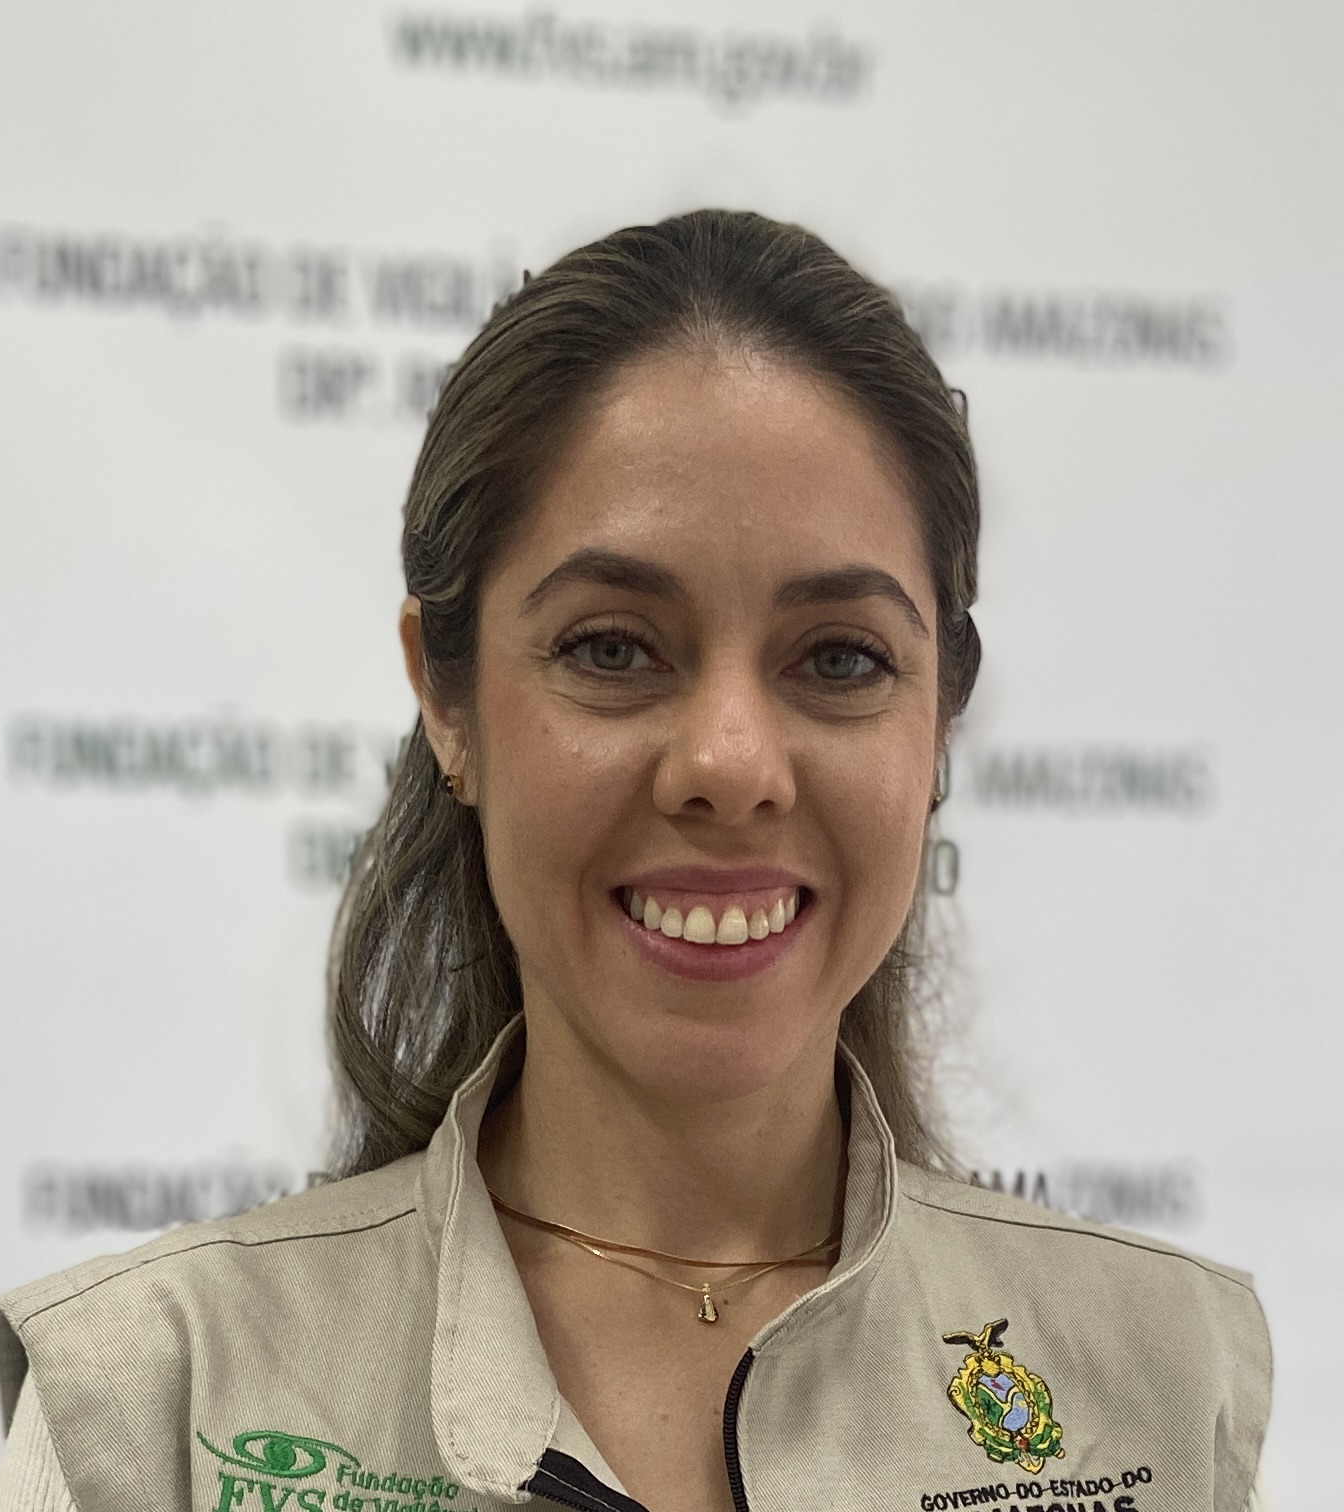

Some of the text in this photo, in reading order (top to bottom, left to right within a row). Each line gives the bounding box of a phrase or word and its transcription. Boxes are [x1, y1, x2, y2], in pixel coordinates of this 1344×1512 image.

[336, 1463, 460, 1501] Fundação
[920, 1466, 1153, 1512] GOVERNO DO ESTADO DO
